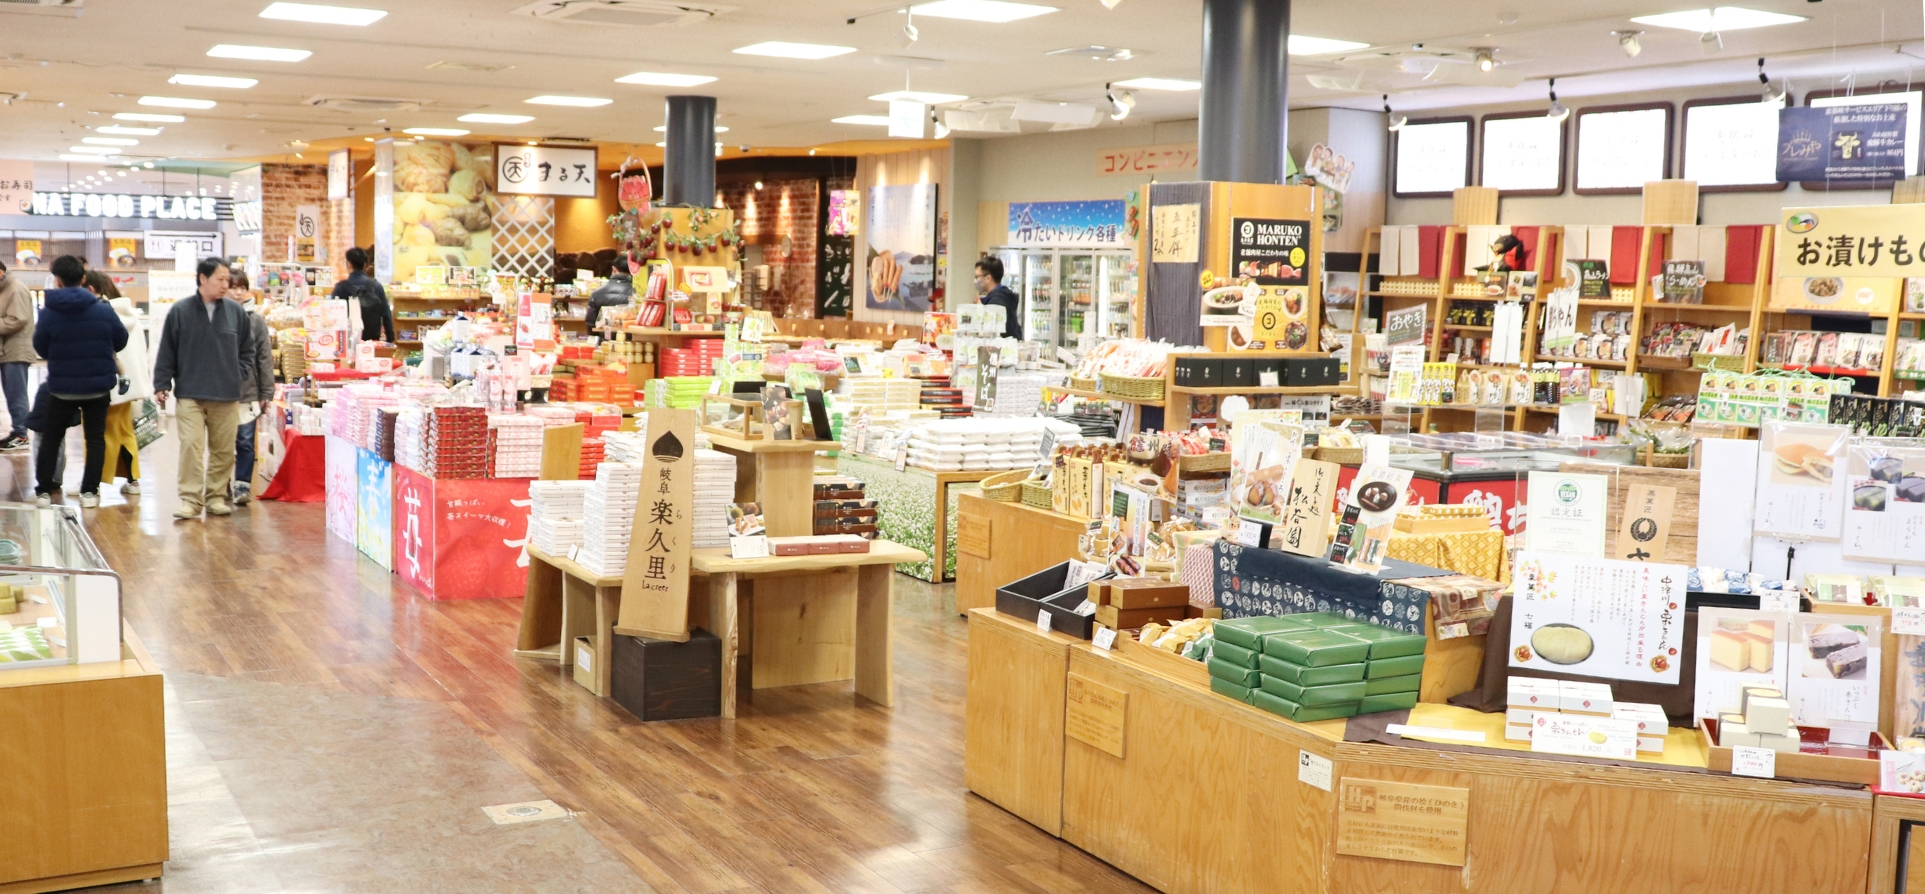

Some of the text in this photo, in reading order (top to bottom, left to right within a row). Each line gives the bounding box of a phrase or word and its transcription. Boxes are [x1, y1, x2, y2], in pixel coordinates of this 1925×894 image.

[538, 161, 591, 184] まる天
[1104, 149, 1198, 173] コンビニエン
[33, 192, 217, 220] NA FOOD PLACE
[1016, 206, 1117, 244] 冷たいドリンク各種
[1257, 223, 1302, 236] MARUKO
[1256, 235, 1299, 246] HONTEN
[1391, 311, 1422, 331] おやき
[658, 467, 672, 495] 岐阜
[1550, 507, 1584, 518] 認定証
[645, 498, 674, 580] 楽久里
[1526, 573, 1537, 601] 栗菓匠
[1660, 575, 1673, 606] 中津川
[1523, 613, 1534, 630] 七福
[1394, 803, 1442, 815] 間伐材を使用
